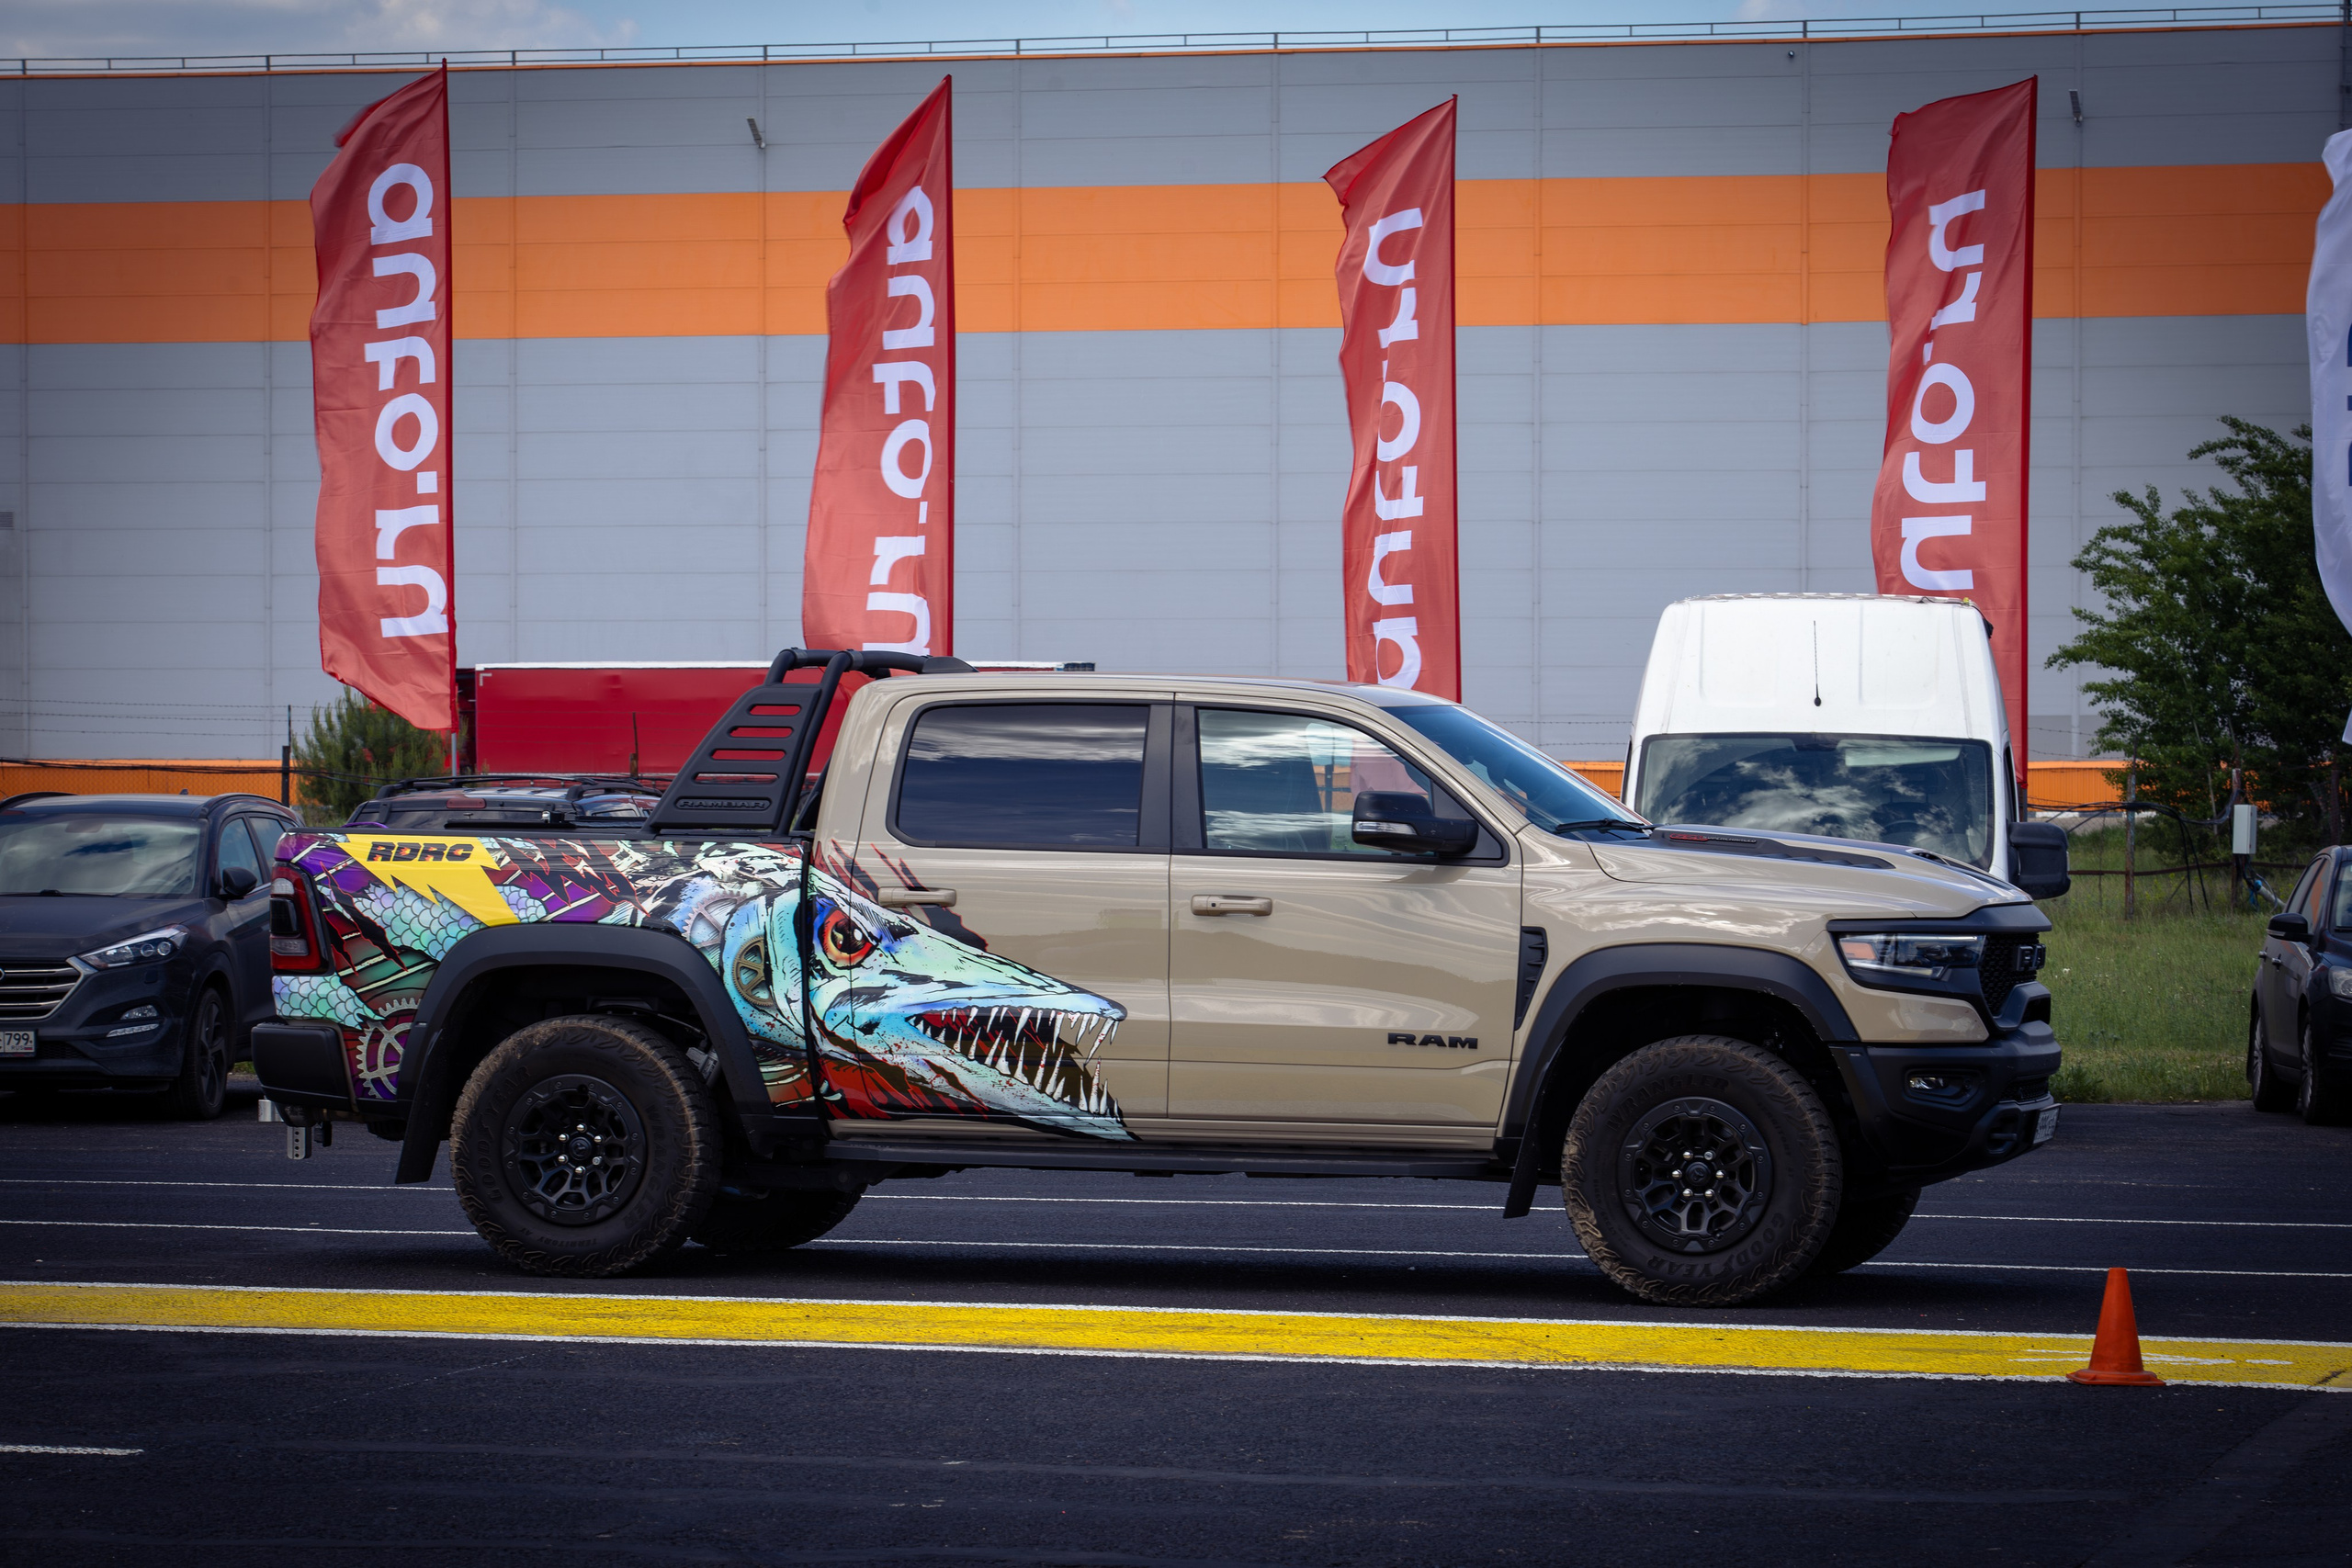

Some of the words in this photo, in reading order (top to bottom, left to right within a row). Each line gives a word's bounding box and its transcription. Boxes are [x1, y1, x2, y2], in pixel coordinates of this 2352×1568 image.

[681, 801, 764, 810] RAMBAR
[367, 841, 474, 863] RDRC
[2017, 944, 2046, 971] RA
[5, 1032, 29, 1045] 799
[1387, 1032, 1478, 1049] RAM
[1646, 1212, 1785, 1279] GOODYEAR
